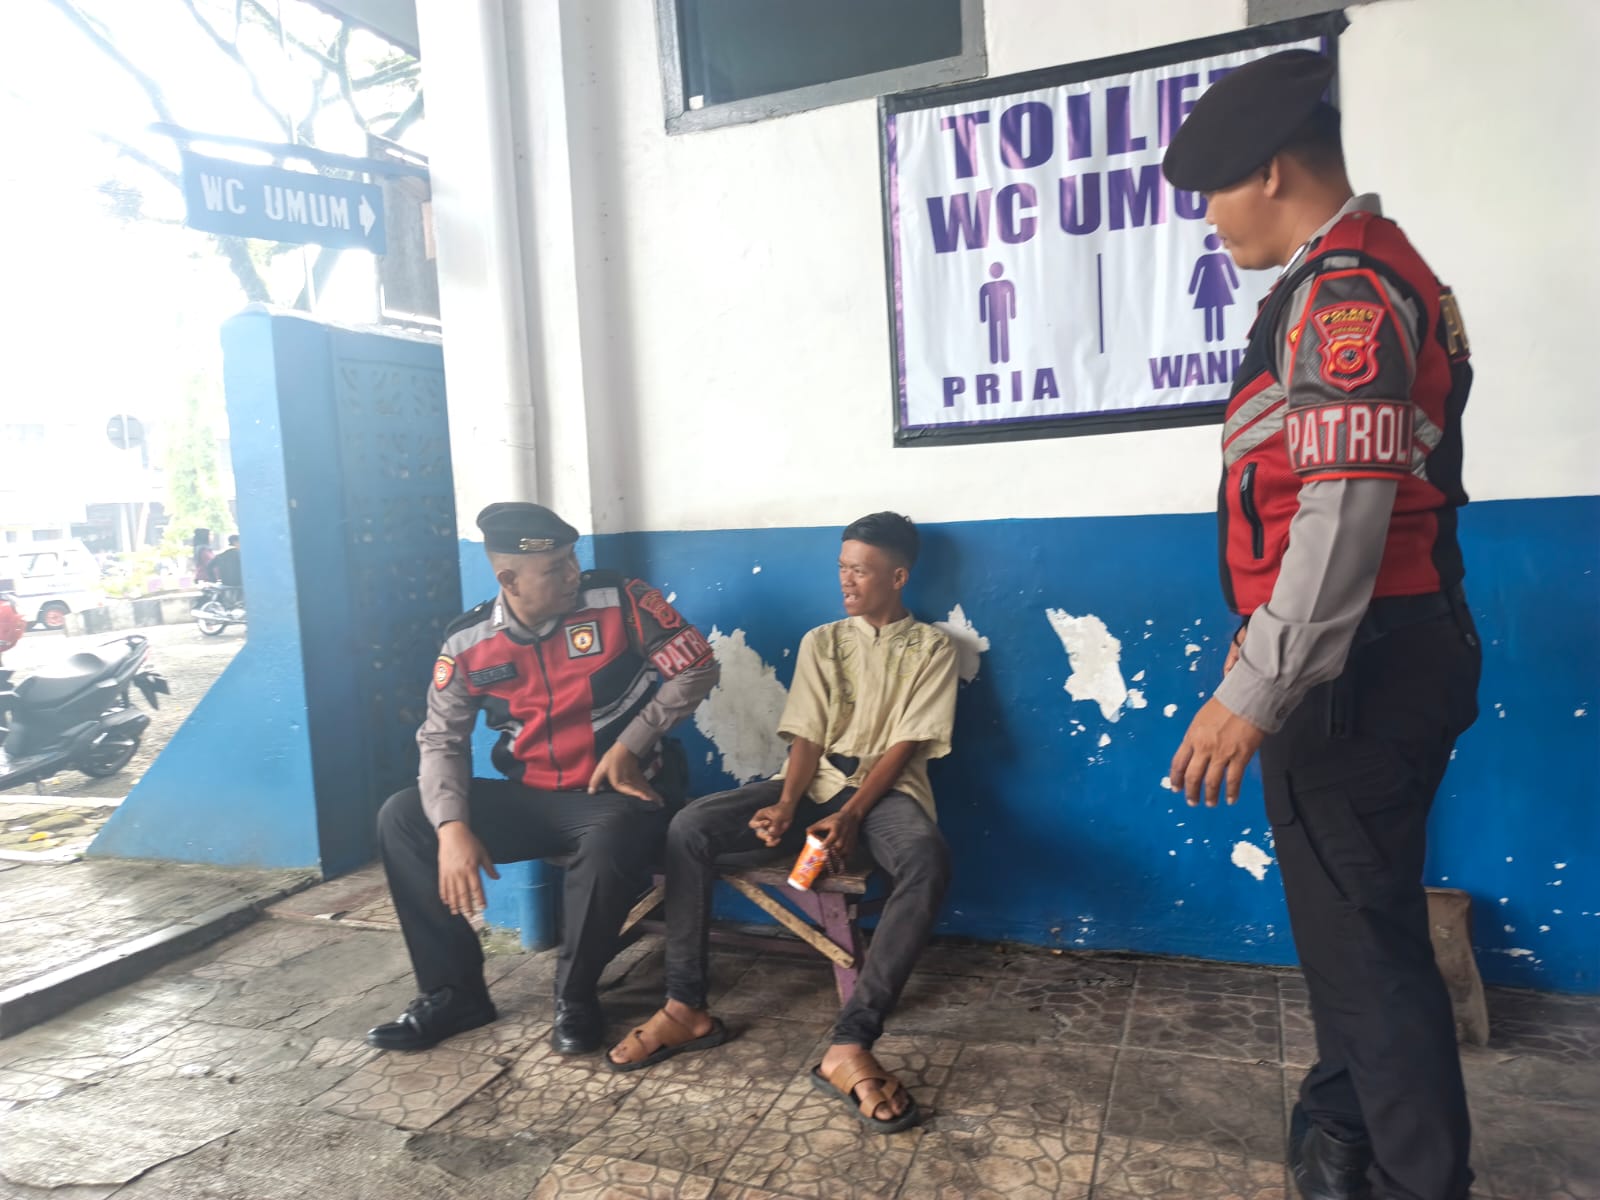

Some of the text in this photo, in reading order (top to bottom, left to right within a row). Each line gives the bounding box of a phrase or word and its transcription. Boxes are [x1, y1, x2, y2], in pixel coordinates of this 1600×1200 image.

[200, 174, 350, 230] WC UMUM
[926, 181, 1039, 254] WC
[942, 367, 1060, 407] PRIA
[1148, 348, 1248, 390] WANI
[1286, 404, 1411, 468] PATROL
[653, 630, 710, 677] PATR
